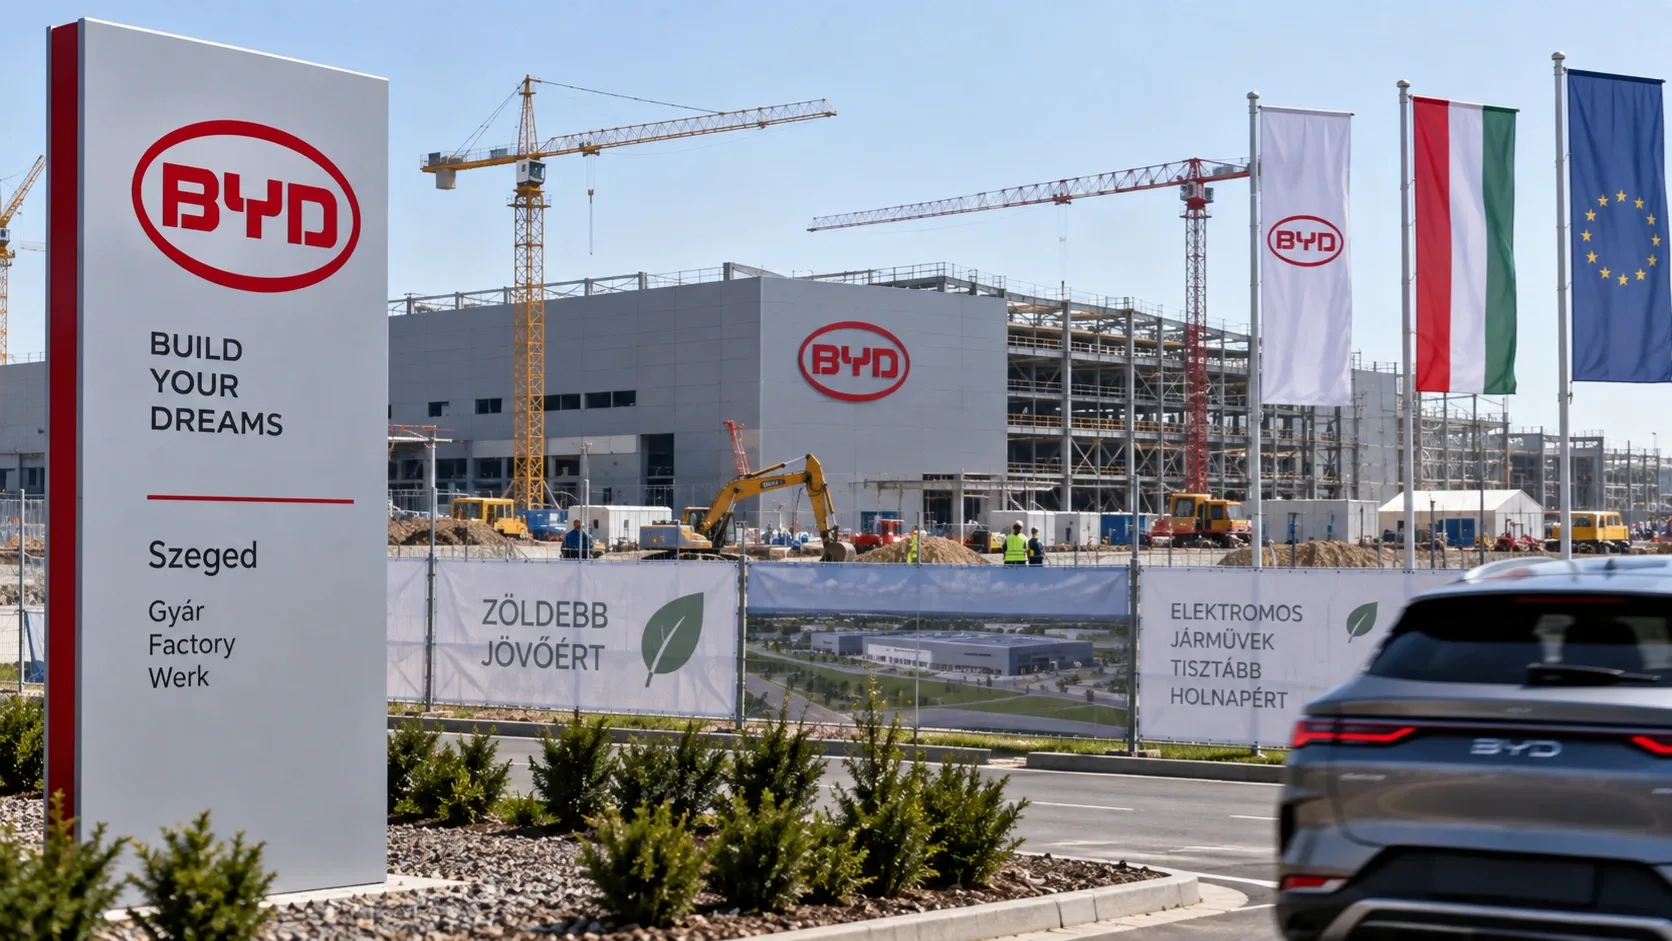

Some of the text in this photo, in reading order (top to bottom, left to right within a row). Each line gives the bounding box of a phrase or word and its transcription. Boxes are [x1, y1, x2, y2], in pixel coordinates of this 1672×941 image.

[163, 162, 338, 249] BYD
[1276, 230, 1336, 252] BYD
[150, 331, 243, 362] BUILD
[811, 344, 899, 379] BYD
[150, 367, 239, 398] YOUR
[150, 406, 283, 437] DREAMS
[148, 540, 257, 577] Szeged
[148, 599, 205, 628] Gyár
[481, 592, 609, 629] ZÖLDEBB
[1171, 603, 1302, 622] ELEKTROMOS
[149, 633, 236, 660] Factory
[481, 635, 606, 671] JÖVŐÉRT
[1171, 627, 1274, 650] JÁRMŰVEK
[148, 665, 210, 689] Werk
[1171, 657, 1261, 679] TISZTÁBB
[1171, 687, 1288, 708] HOLNAPÉRT
[1470, 738, 1563, 758] BYD
